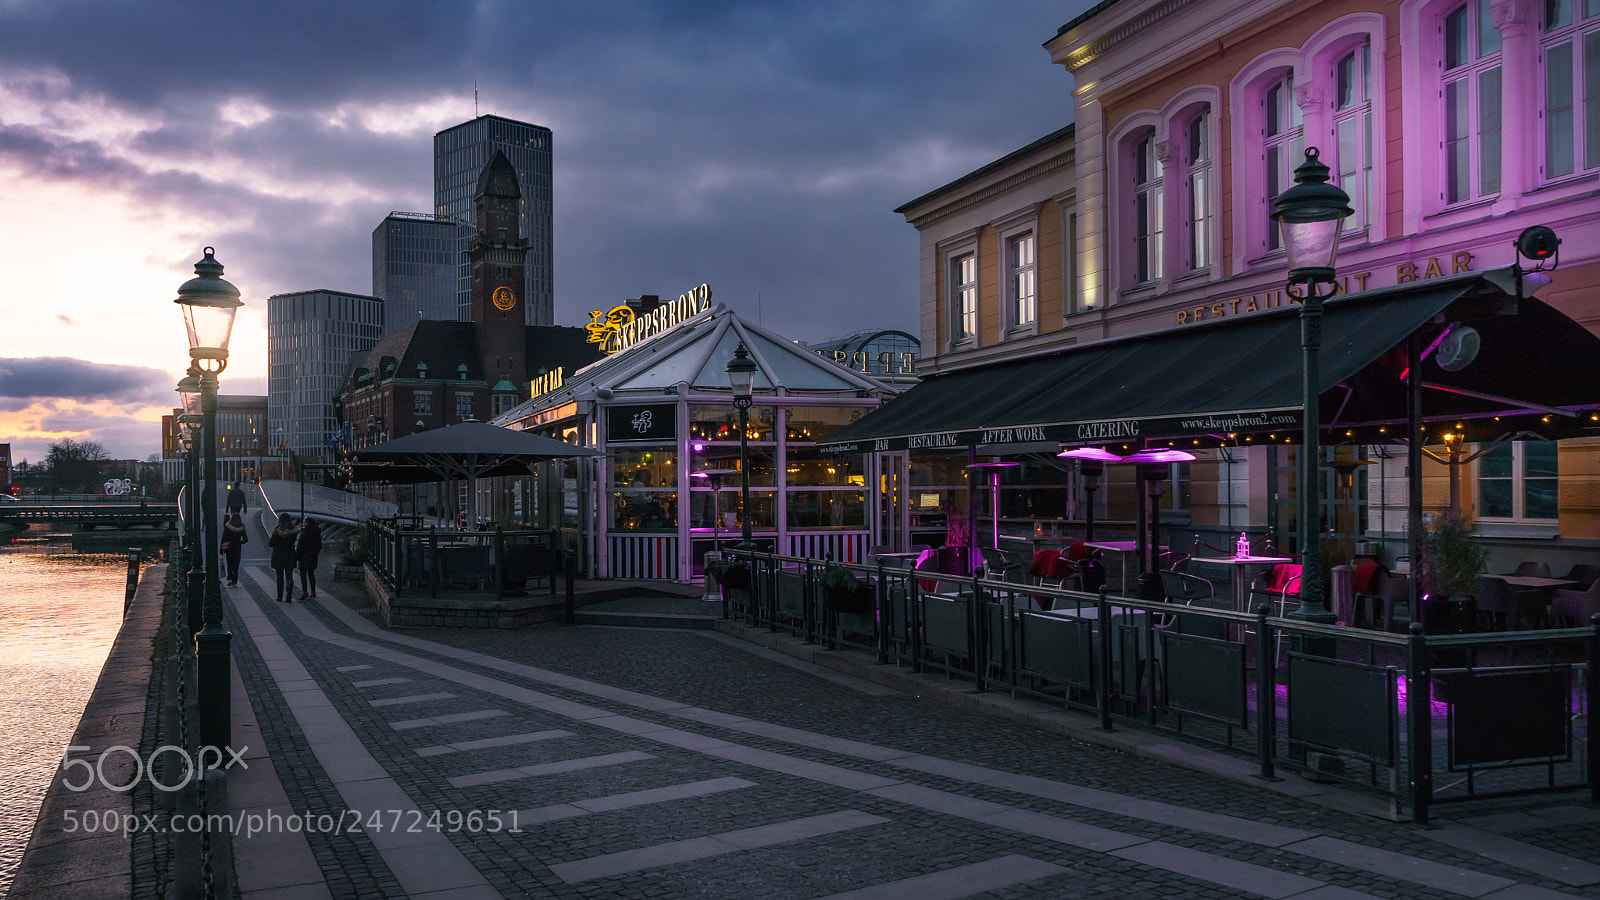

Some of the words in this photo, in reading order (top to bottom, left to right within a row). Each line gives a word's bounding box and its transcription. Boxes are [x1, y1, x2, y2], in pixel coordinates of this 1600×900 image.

[1176, 272, 1371, 326] RESTAURNT
[1397, 251, 1474, 285] BAR
[530, 376, 543, 399] MAT
[549, 366, 563, 392] BAR
[1077, 420, 1140, 439] CATERING
[1181, 413, 1297, 431] www.skeppsbron2.com
[908, 433, 957, 449] RESTAURANG
[981, 429, 1013, 444] AFTER
[1015, 426, 1046, 442] WORK
[875, 439, 889, 451] BAR
